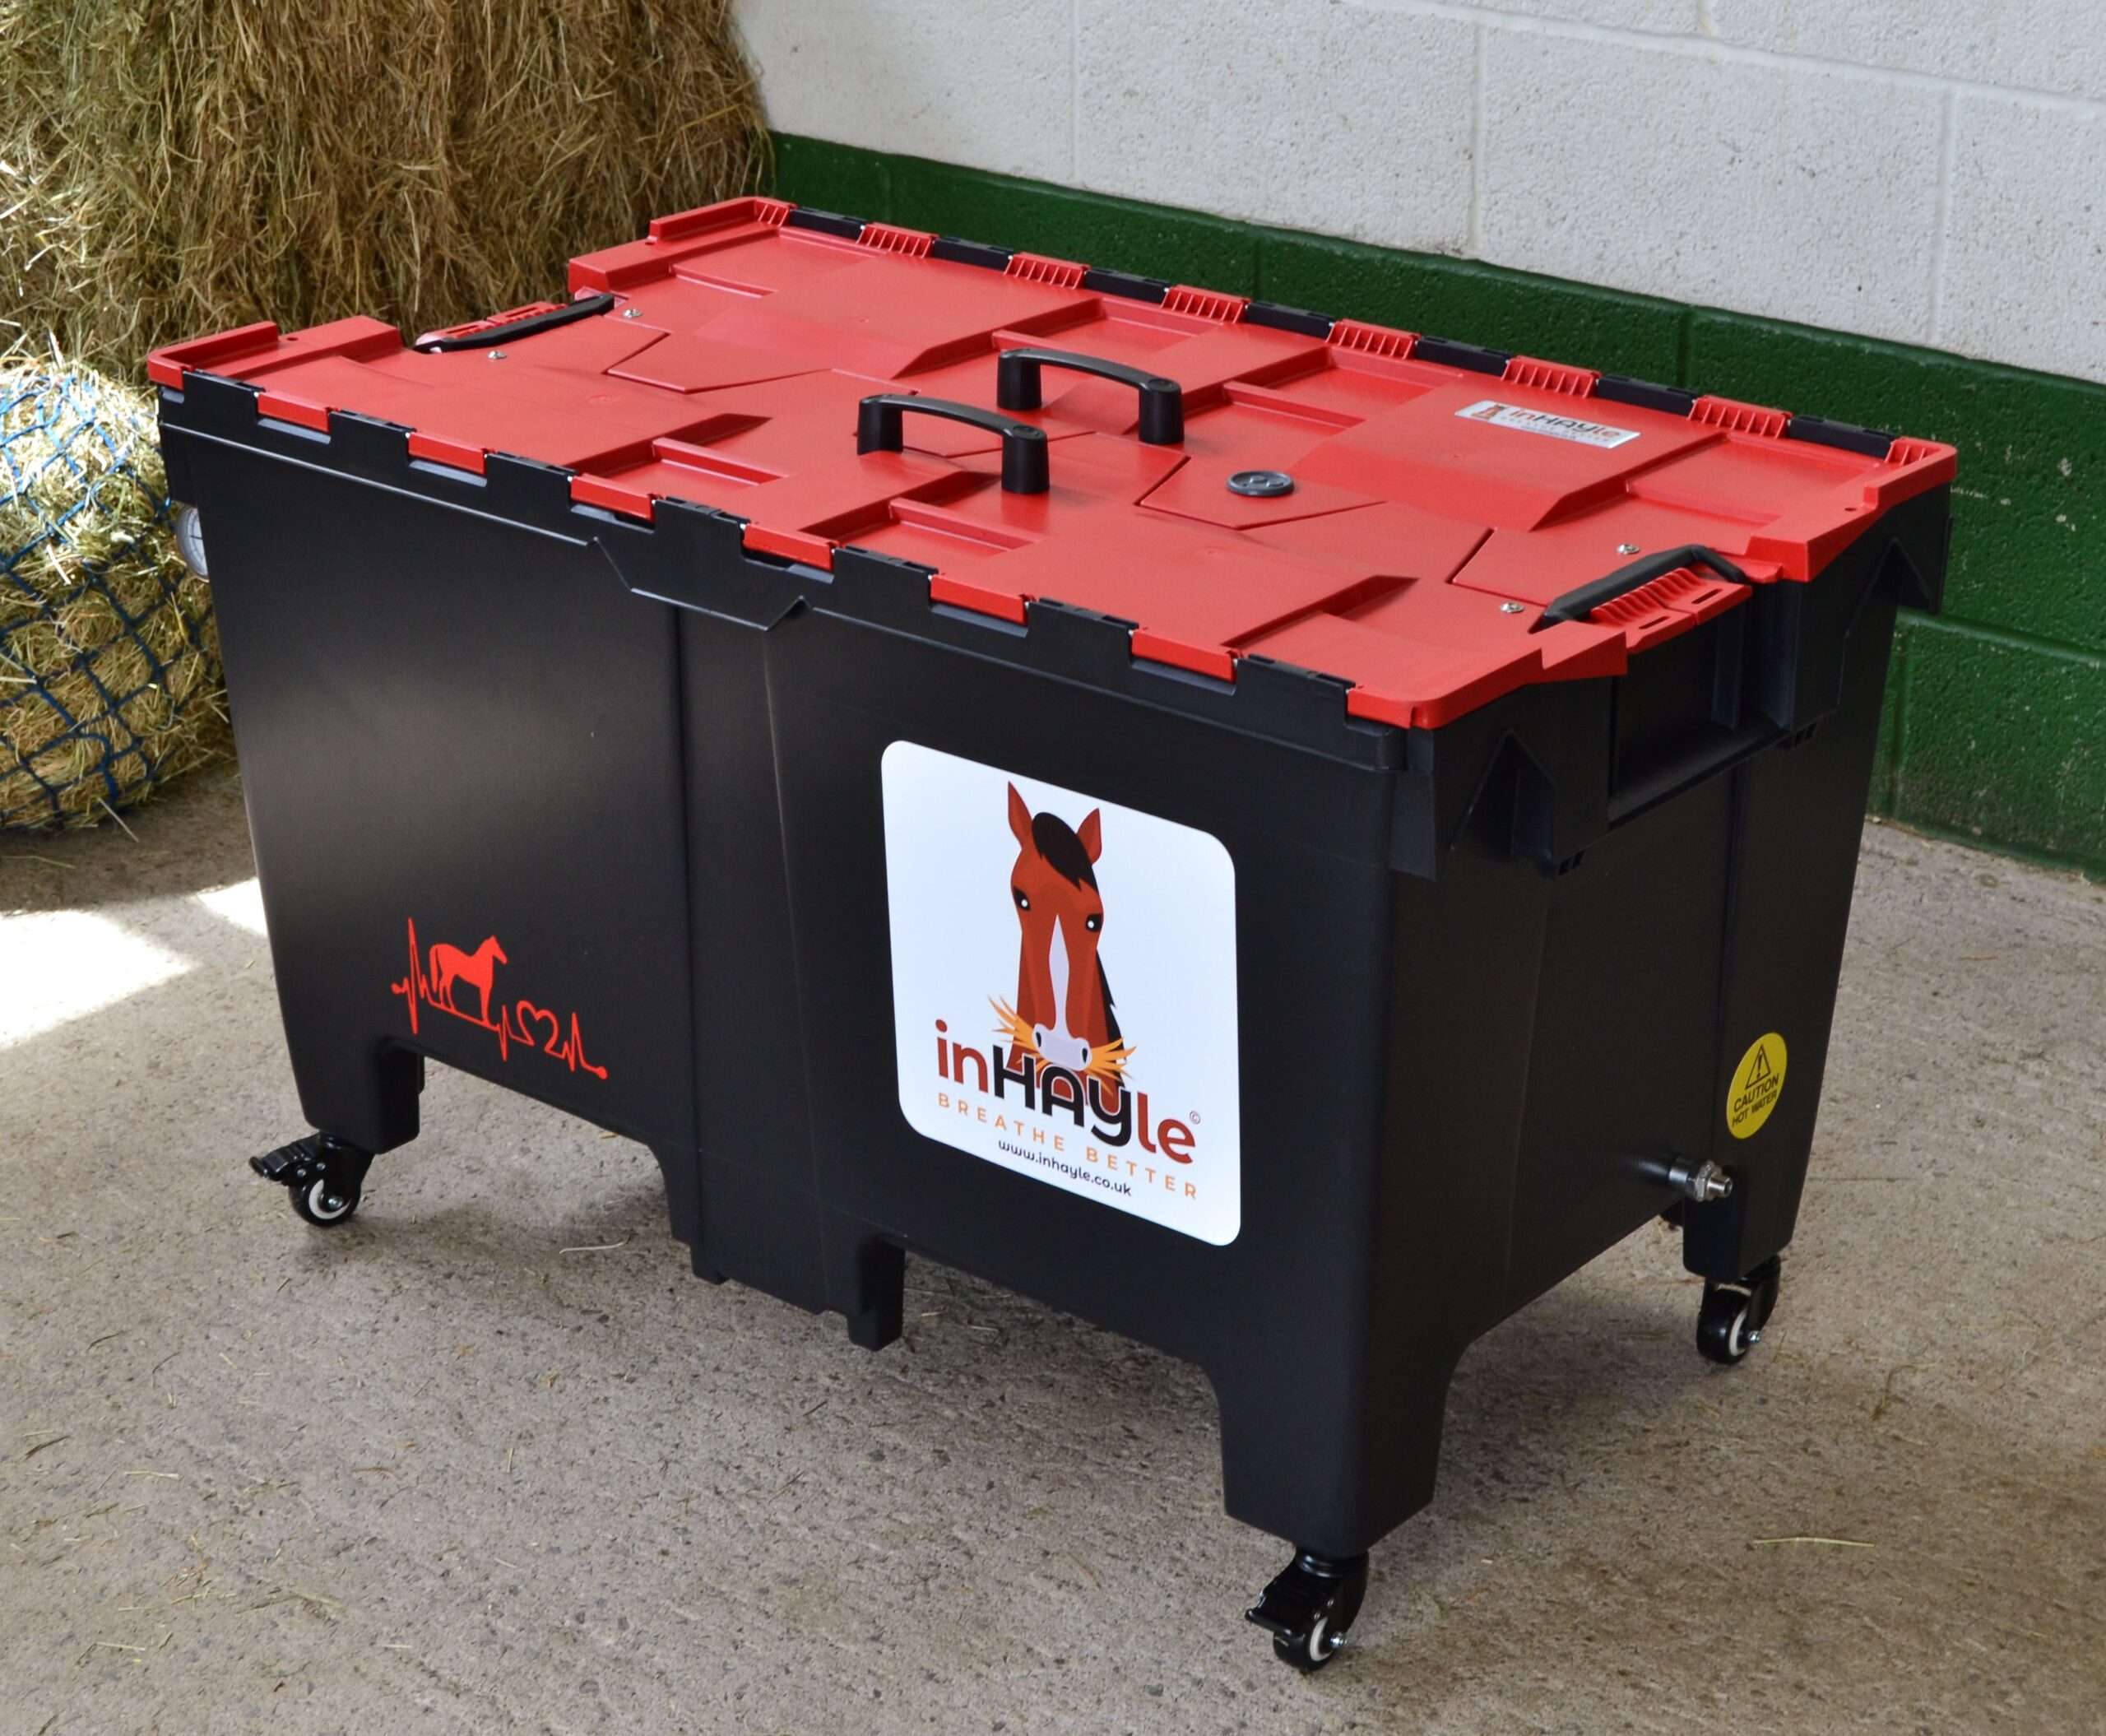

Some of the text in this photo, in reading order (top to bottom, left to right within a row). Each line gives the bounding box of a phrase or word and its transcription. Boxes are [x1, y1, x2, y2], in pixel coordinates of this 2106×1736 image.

[1733, 1073, 1779, 1112] CAUTION
[1732, 1107, 1750, 1127] HOT
[938, 1092, 1197, 1200] BREATHE BETTER
[998, 1140, 1132, 1196] www.inhayle.co.uk
